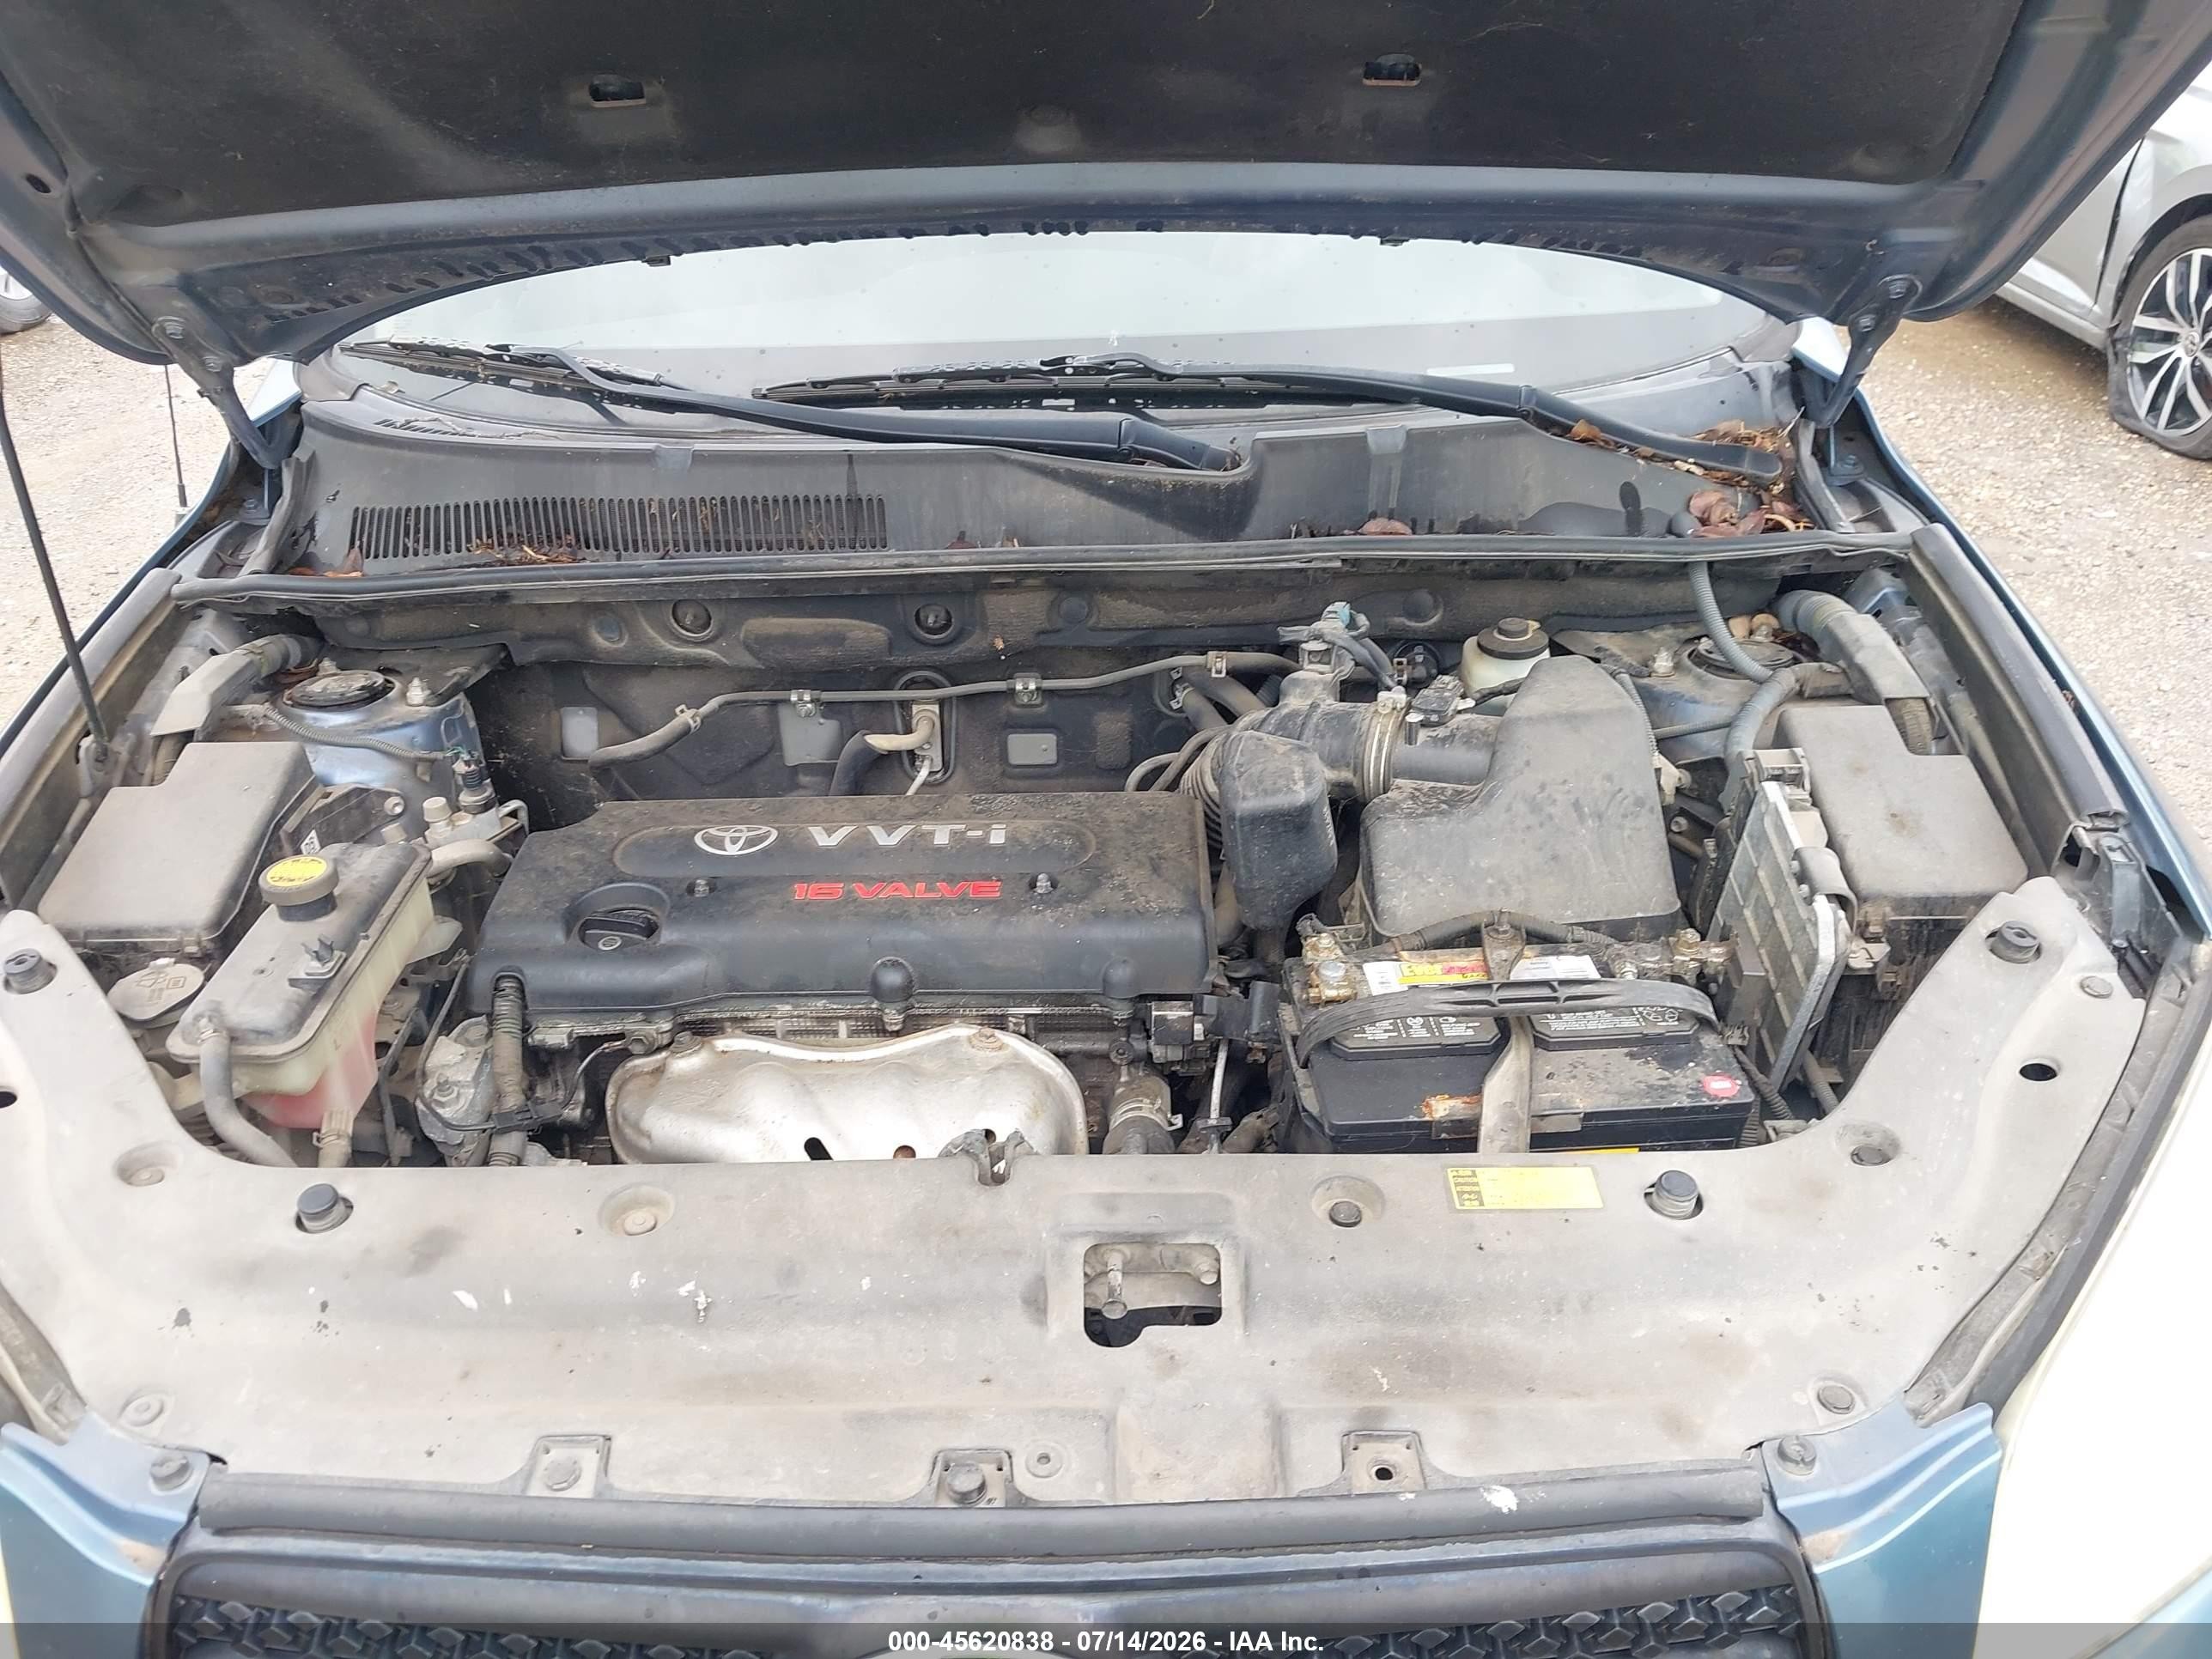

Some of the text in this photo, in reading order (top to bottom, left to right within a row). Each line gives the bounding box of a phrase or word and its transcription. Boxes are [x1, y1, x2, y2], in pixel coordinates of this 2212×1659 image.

[807, 823, 1007, 847] VVT-i
[793, 881, 1003, 900] 16 VALVE
